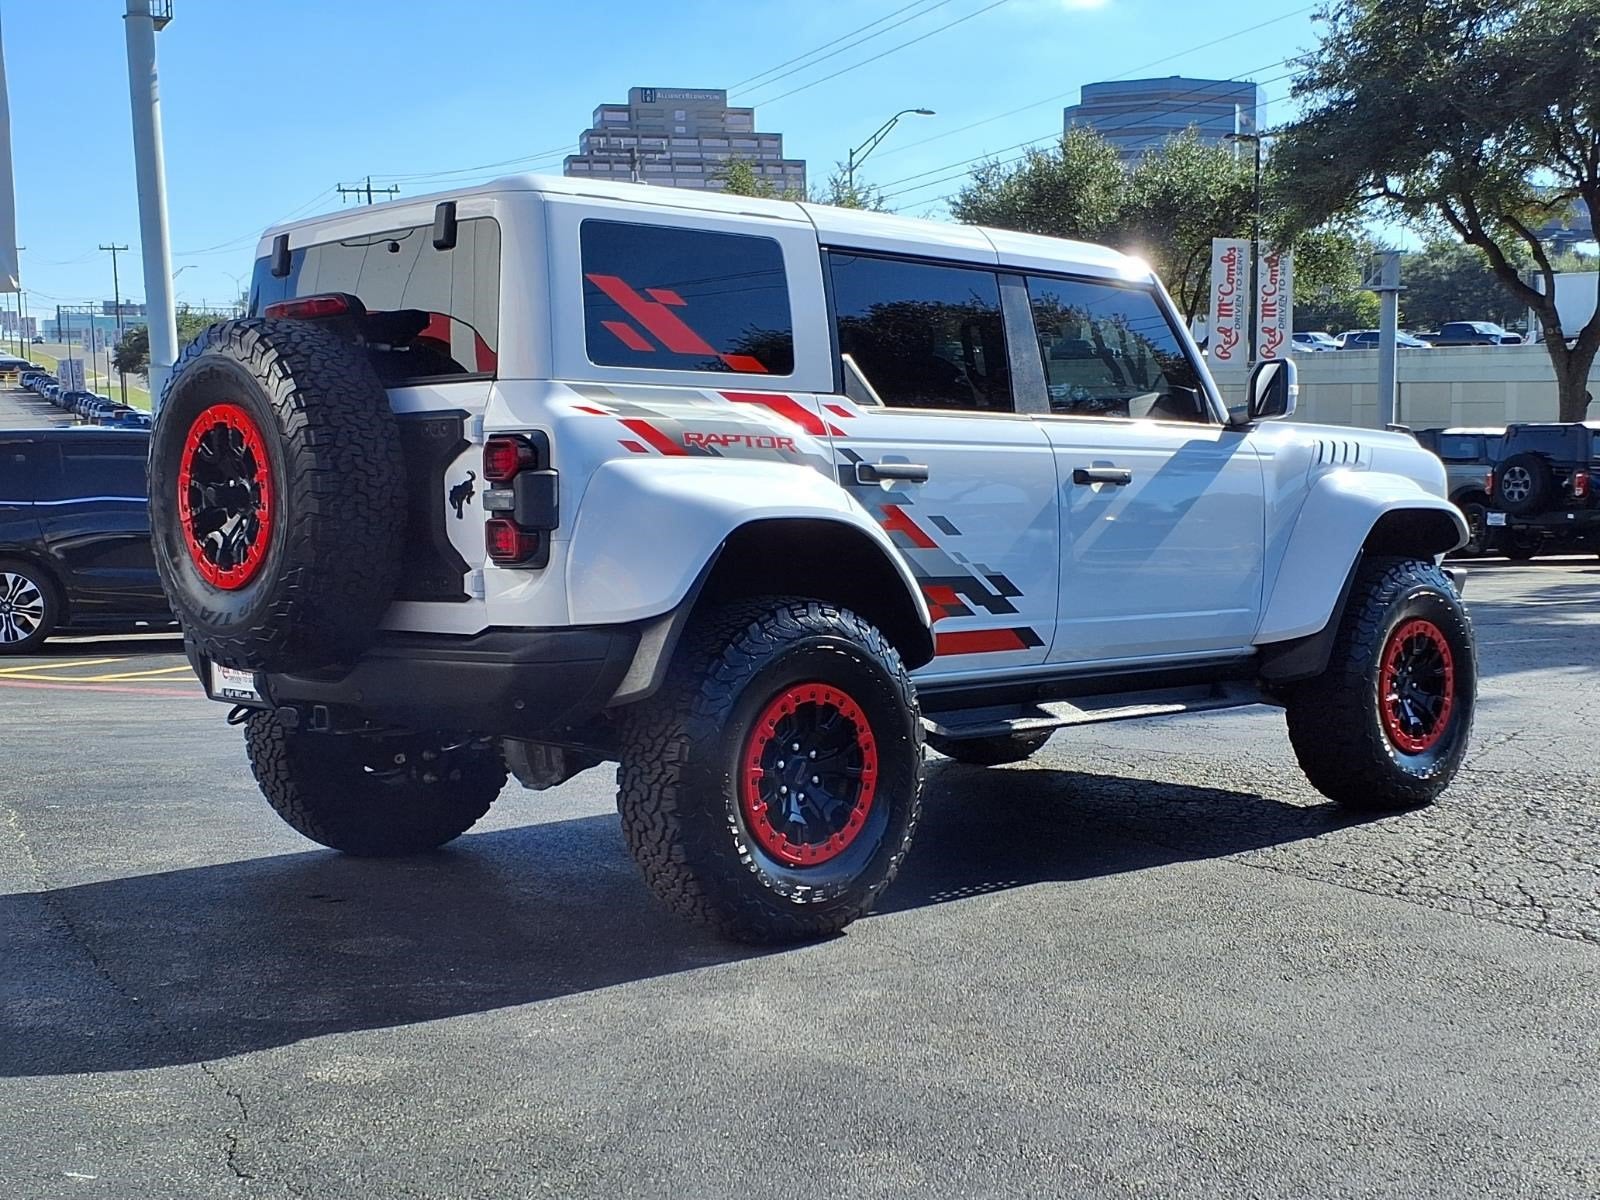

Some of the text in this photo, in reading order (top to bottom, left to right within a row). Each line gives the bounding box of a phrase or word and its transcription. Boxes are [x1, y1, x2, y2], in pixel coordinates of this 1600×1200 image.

[1214, 246, 1240, 360] Red McCombs
[1234, 247, 1244, 330] DRIVEN TO SERVE
[1259, 251, 1284, 360] Red McComb
[1278, 278, 1286, 291] TO
[1278, 294, 1286, 330] DRIVEN
[683, 432, 797, 453] RAPTOR
